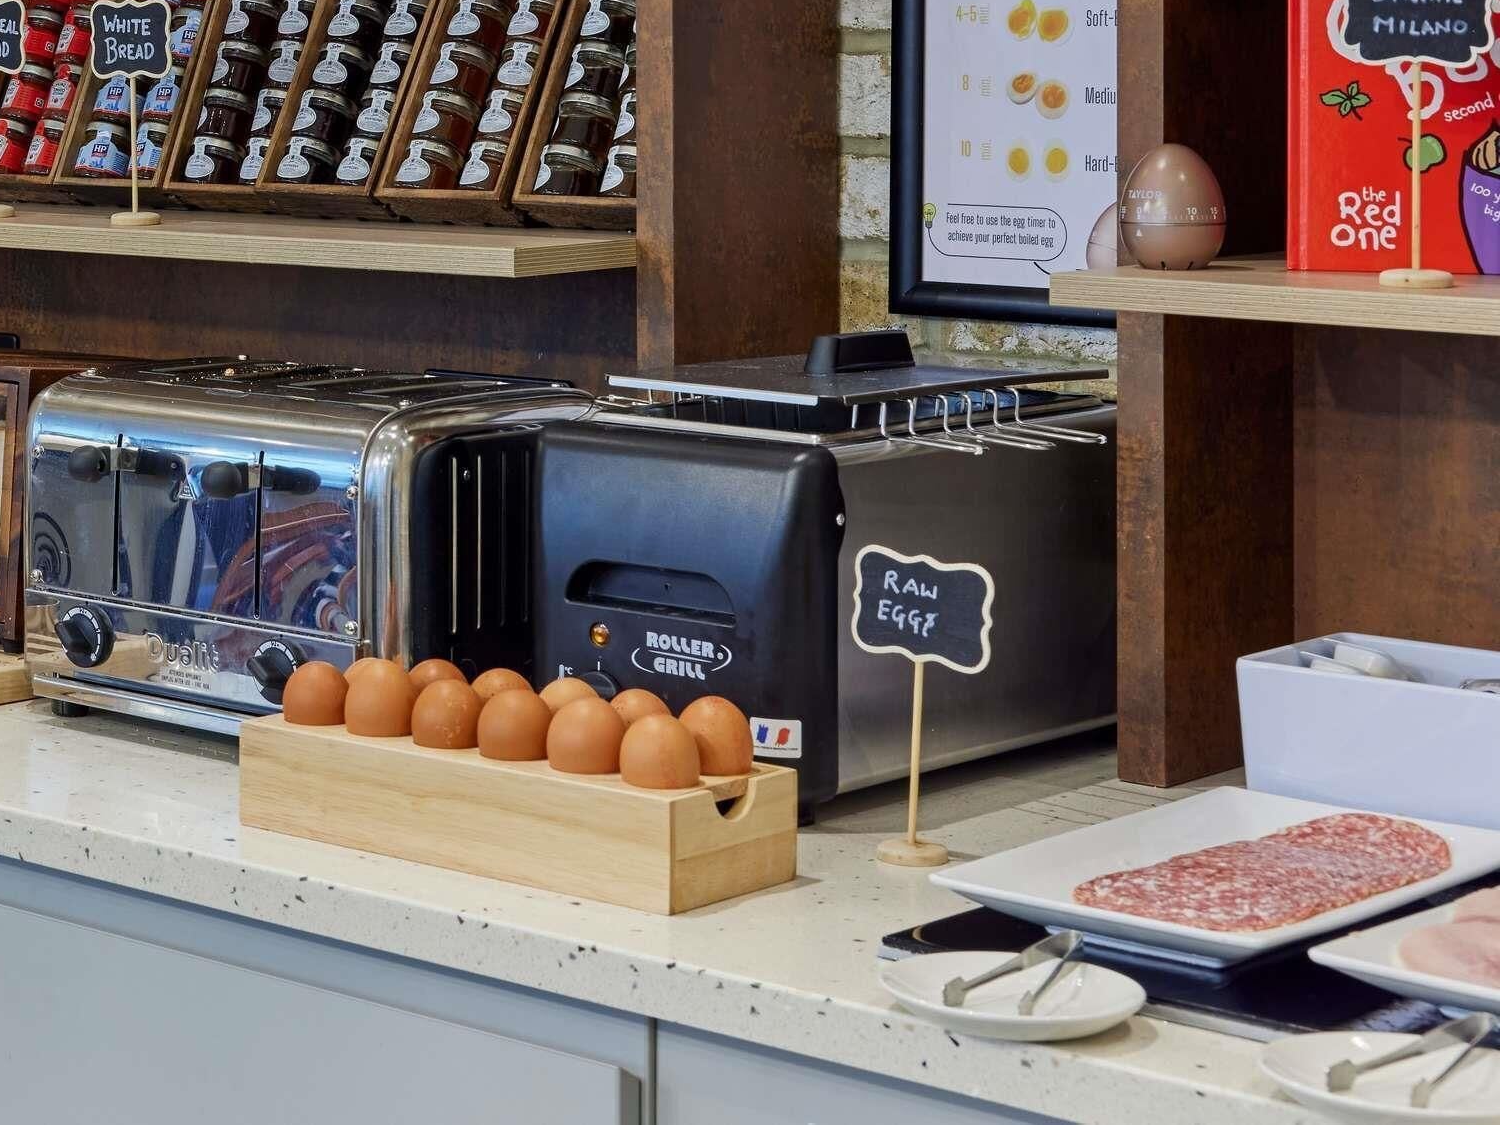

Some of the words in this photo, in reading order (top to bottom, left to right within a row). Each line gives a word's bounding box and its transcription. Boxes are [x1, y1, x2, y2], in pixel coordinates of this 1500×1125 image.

[102, 14, 151, 36] WHITE
[1086, 9, 1118, 27] Soft-
[1372, 15, 1468, 36] MILANO
[184, 31, 197, 39] HP
[104, 37, 155, 65] BREAD
[962, 75, 969, 91] 8
[1444, 91, 1494, 122] second
[961, 140, 971, 157] 10
[1362, 186, 1386, 202] the
[1470, 182, 1491, 197] 100
[1187, 207, 1197, 215] 10
[1338, 190, 1401, 226] Red
[946, 212, 960, 224] Feel
[961, 213, 975, 225] free
[977, 214, 984, 225] to
[986, 216, 998, 226] use
[1000, 215, 1011, 226] the
[1013, 218, 1025, 229] egg
[1027, 217, 1046, 228] timer
[1049, 218, 1056, 229] to
[948, 230, 973, 242] achieve
[974, 234, 990, 245] your
[992, 233, 1017, 246] perfect
[1019, 233, 1039, 246] boiled
[1041, 236, 1054, 248] egg
[1330, 222, 1397, 250] one
[884, 570, 938, 600] RAW
[146, 632, 220, 674] Dualit
[646, 631, 715, 659] ROLLER
[653, 656, 706, 681] GRILL
